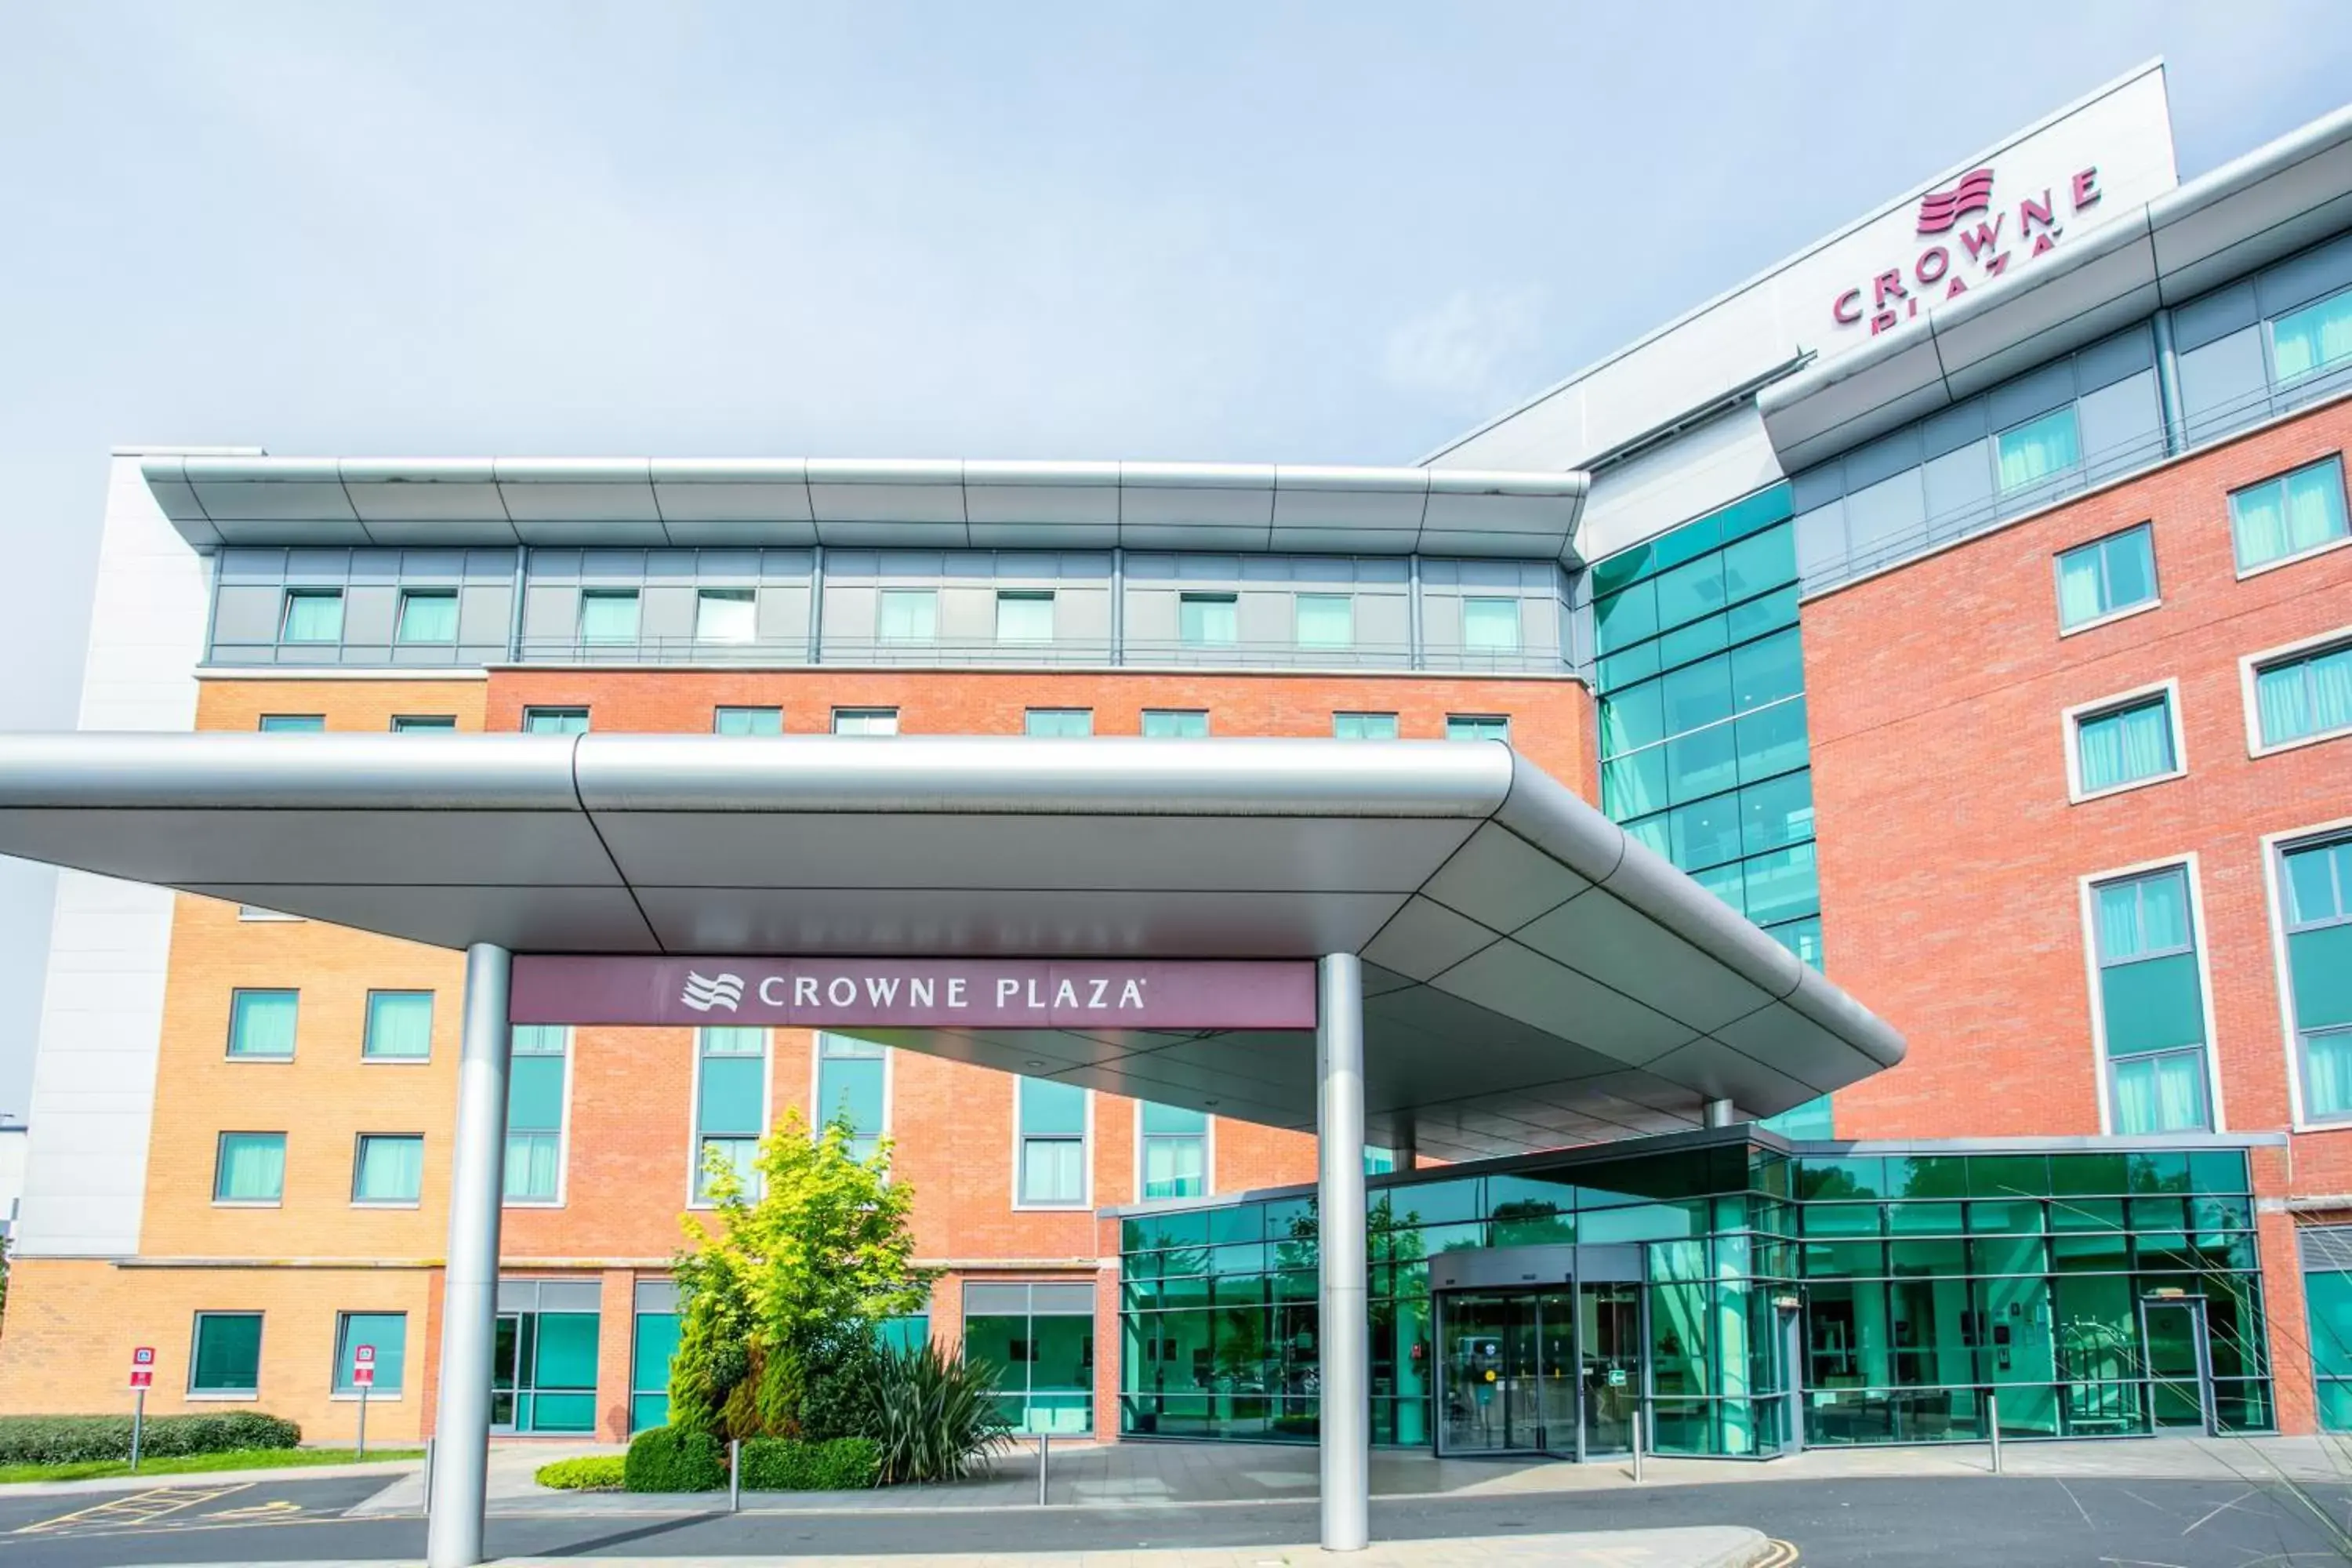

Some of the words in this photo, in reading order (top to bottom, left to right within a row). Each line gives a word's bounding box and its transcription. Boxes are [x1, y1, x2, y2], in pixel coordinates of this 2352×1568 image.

[1834, 167, 2101, 323] CROWNE
[759, 977, 969, 1008] CROWNE
[996, 978, 1145, 1009] PLAZA
